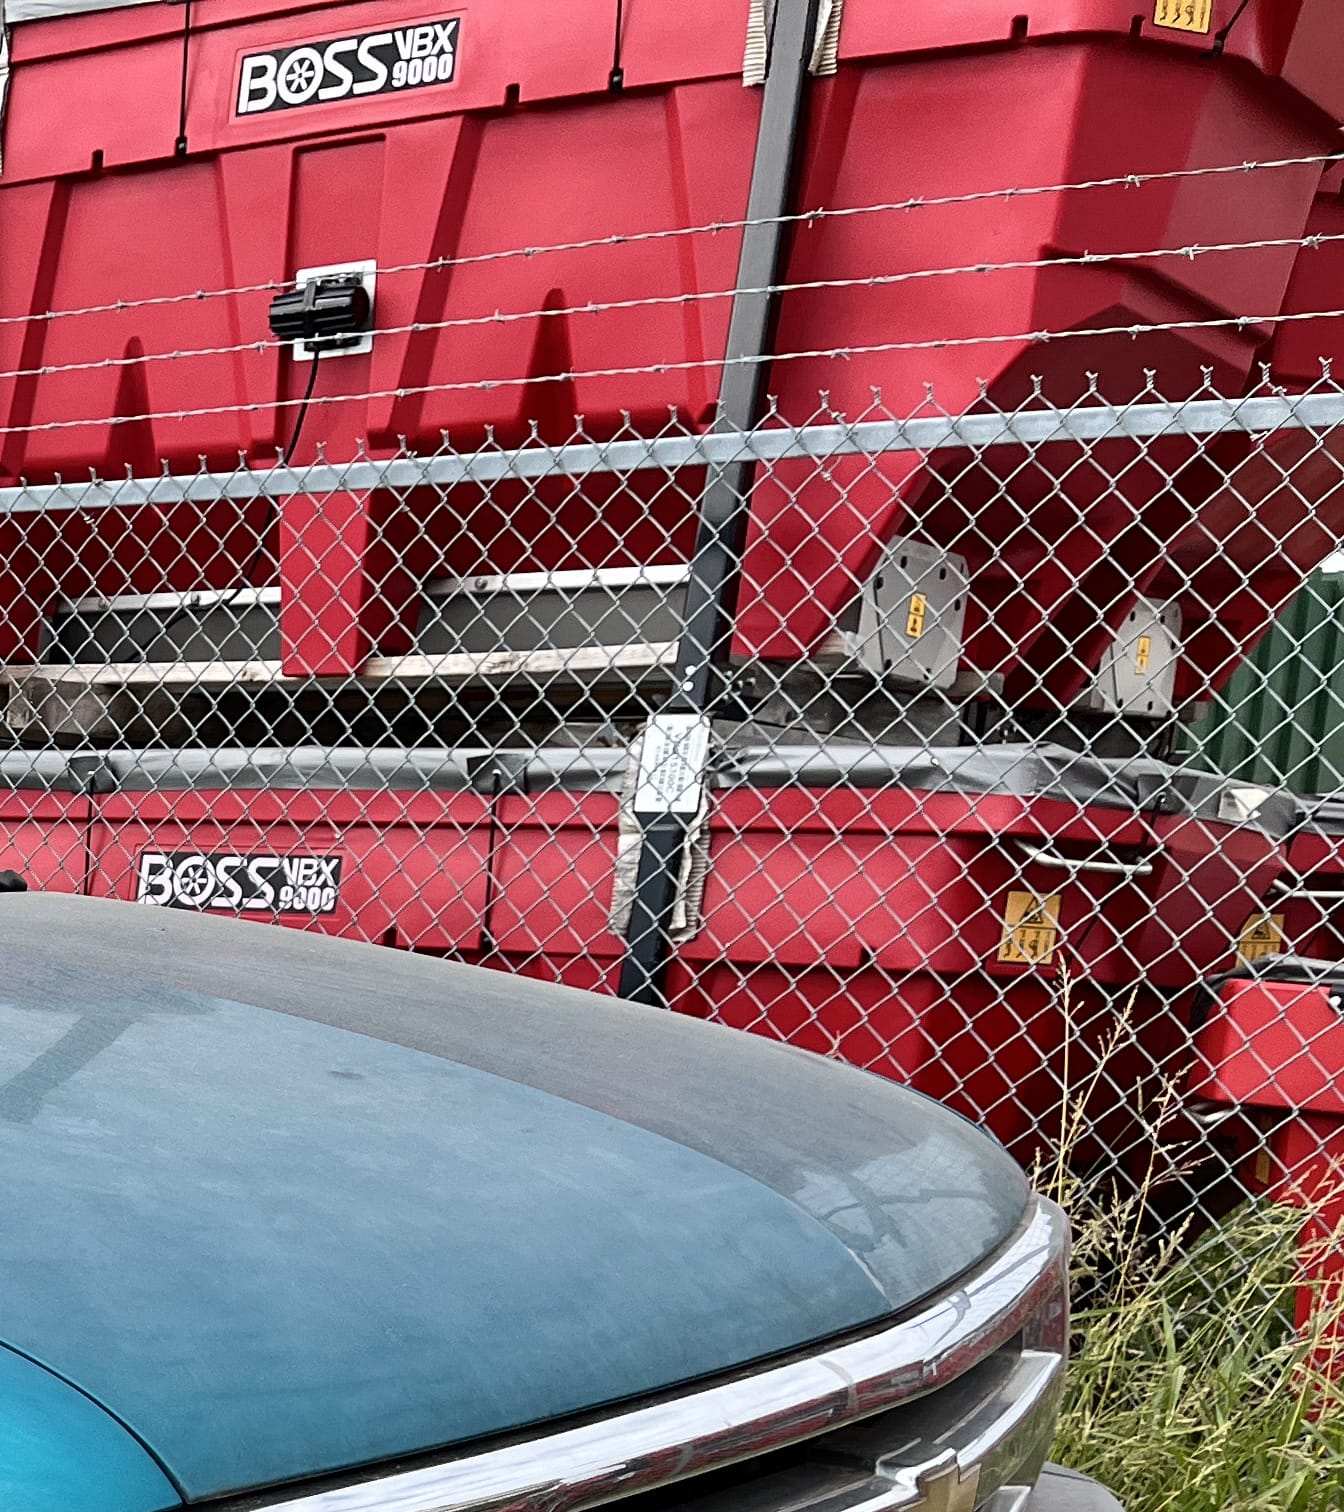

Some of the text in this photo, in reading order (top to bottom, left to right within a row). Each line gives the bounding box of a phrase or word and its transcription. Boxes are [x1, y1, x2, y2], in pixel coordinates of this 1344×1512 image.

[238, 21, 457, 114] BOSS VBX
[391, 54, 454, 87] 9000
[138, 854, 340, 909] BOSS VBX
[278, 885, 336, 911] 9000
